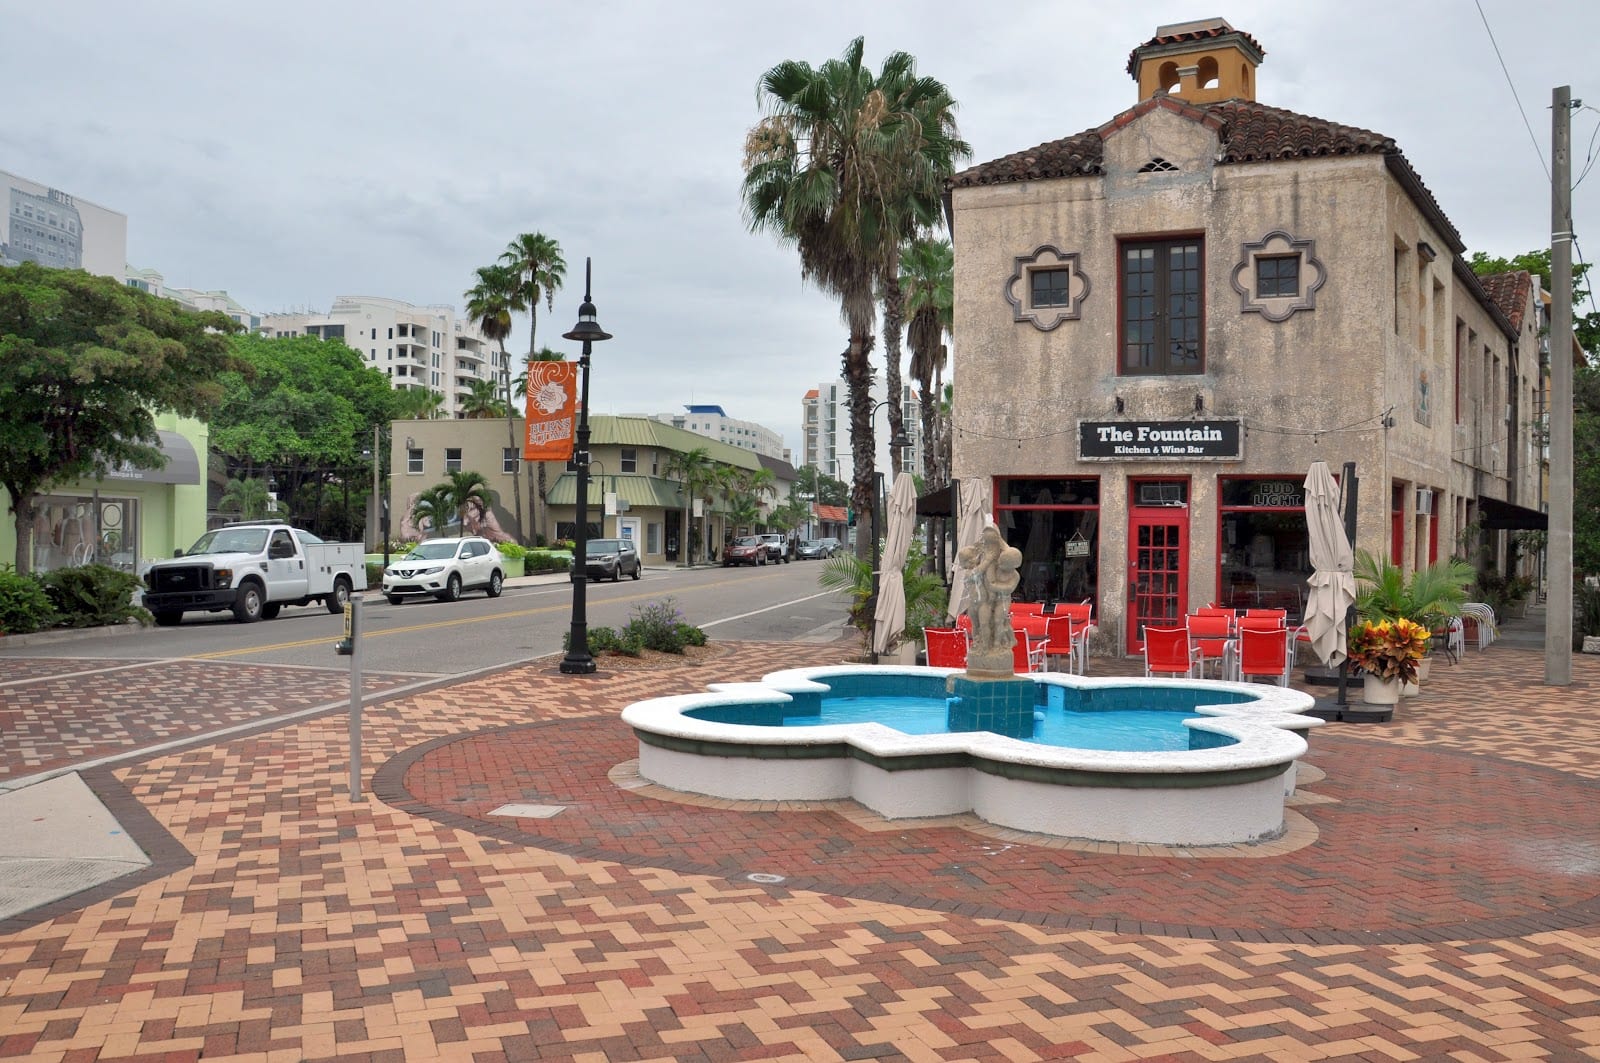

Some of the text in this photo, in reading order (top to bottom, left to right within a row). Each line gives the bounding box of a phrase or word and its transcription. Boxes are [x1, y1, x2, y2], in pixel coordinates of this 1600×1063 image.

[530, 417, 570, 433] BURNS
[529, 430, 570, 445] SQUARE
[1097, 426, 1222, 441] The Fountain
[1114, 446, 1204, 454] Kitchen & Wine Bar
[1260, 483, 1294, 494] BUD
[1254, 494, 1301, 507] LIGHT
